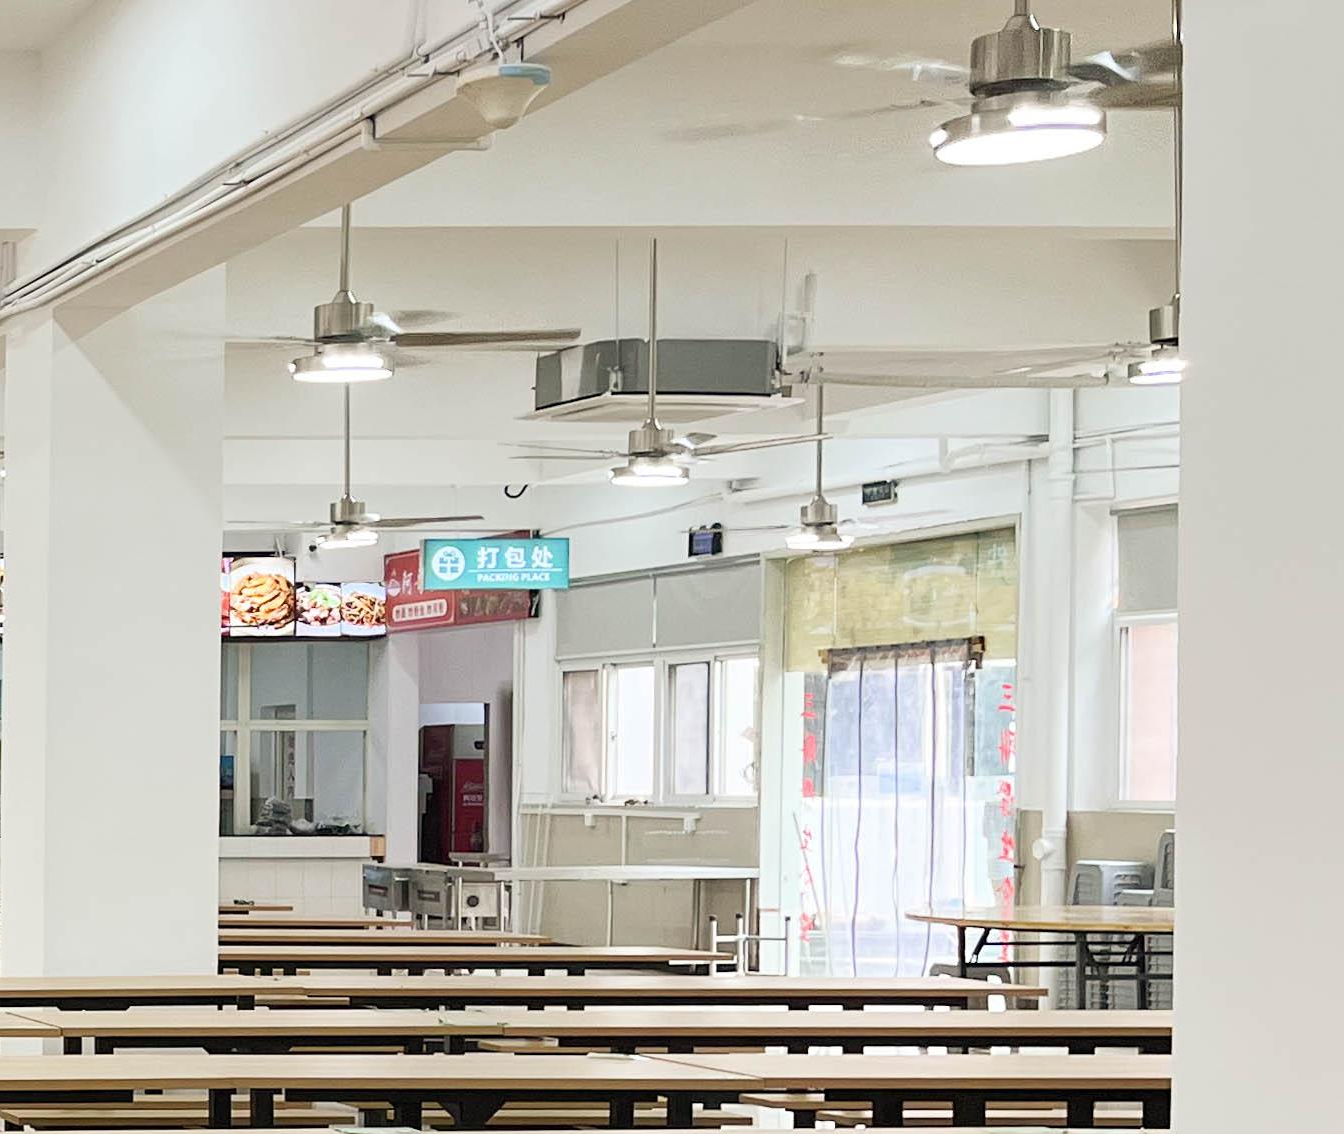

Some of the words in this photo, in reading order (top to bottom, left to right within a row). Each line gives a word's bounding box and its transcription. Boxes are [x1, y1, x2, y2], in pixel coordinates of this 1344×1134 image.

[477, 546, 553, 569] 打包处
[477, 572, 520, 583] PACKING
[521, 572, 551, 583] PLACE
